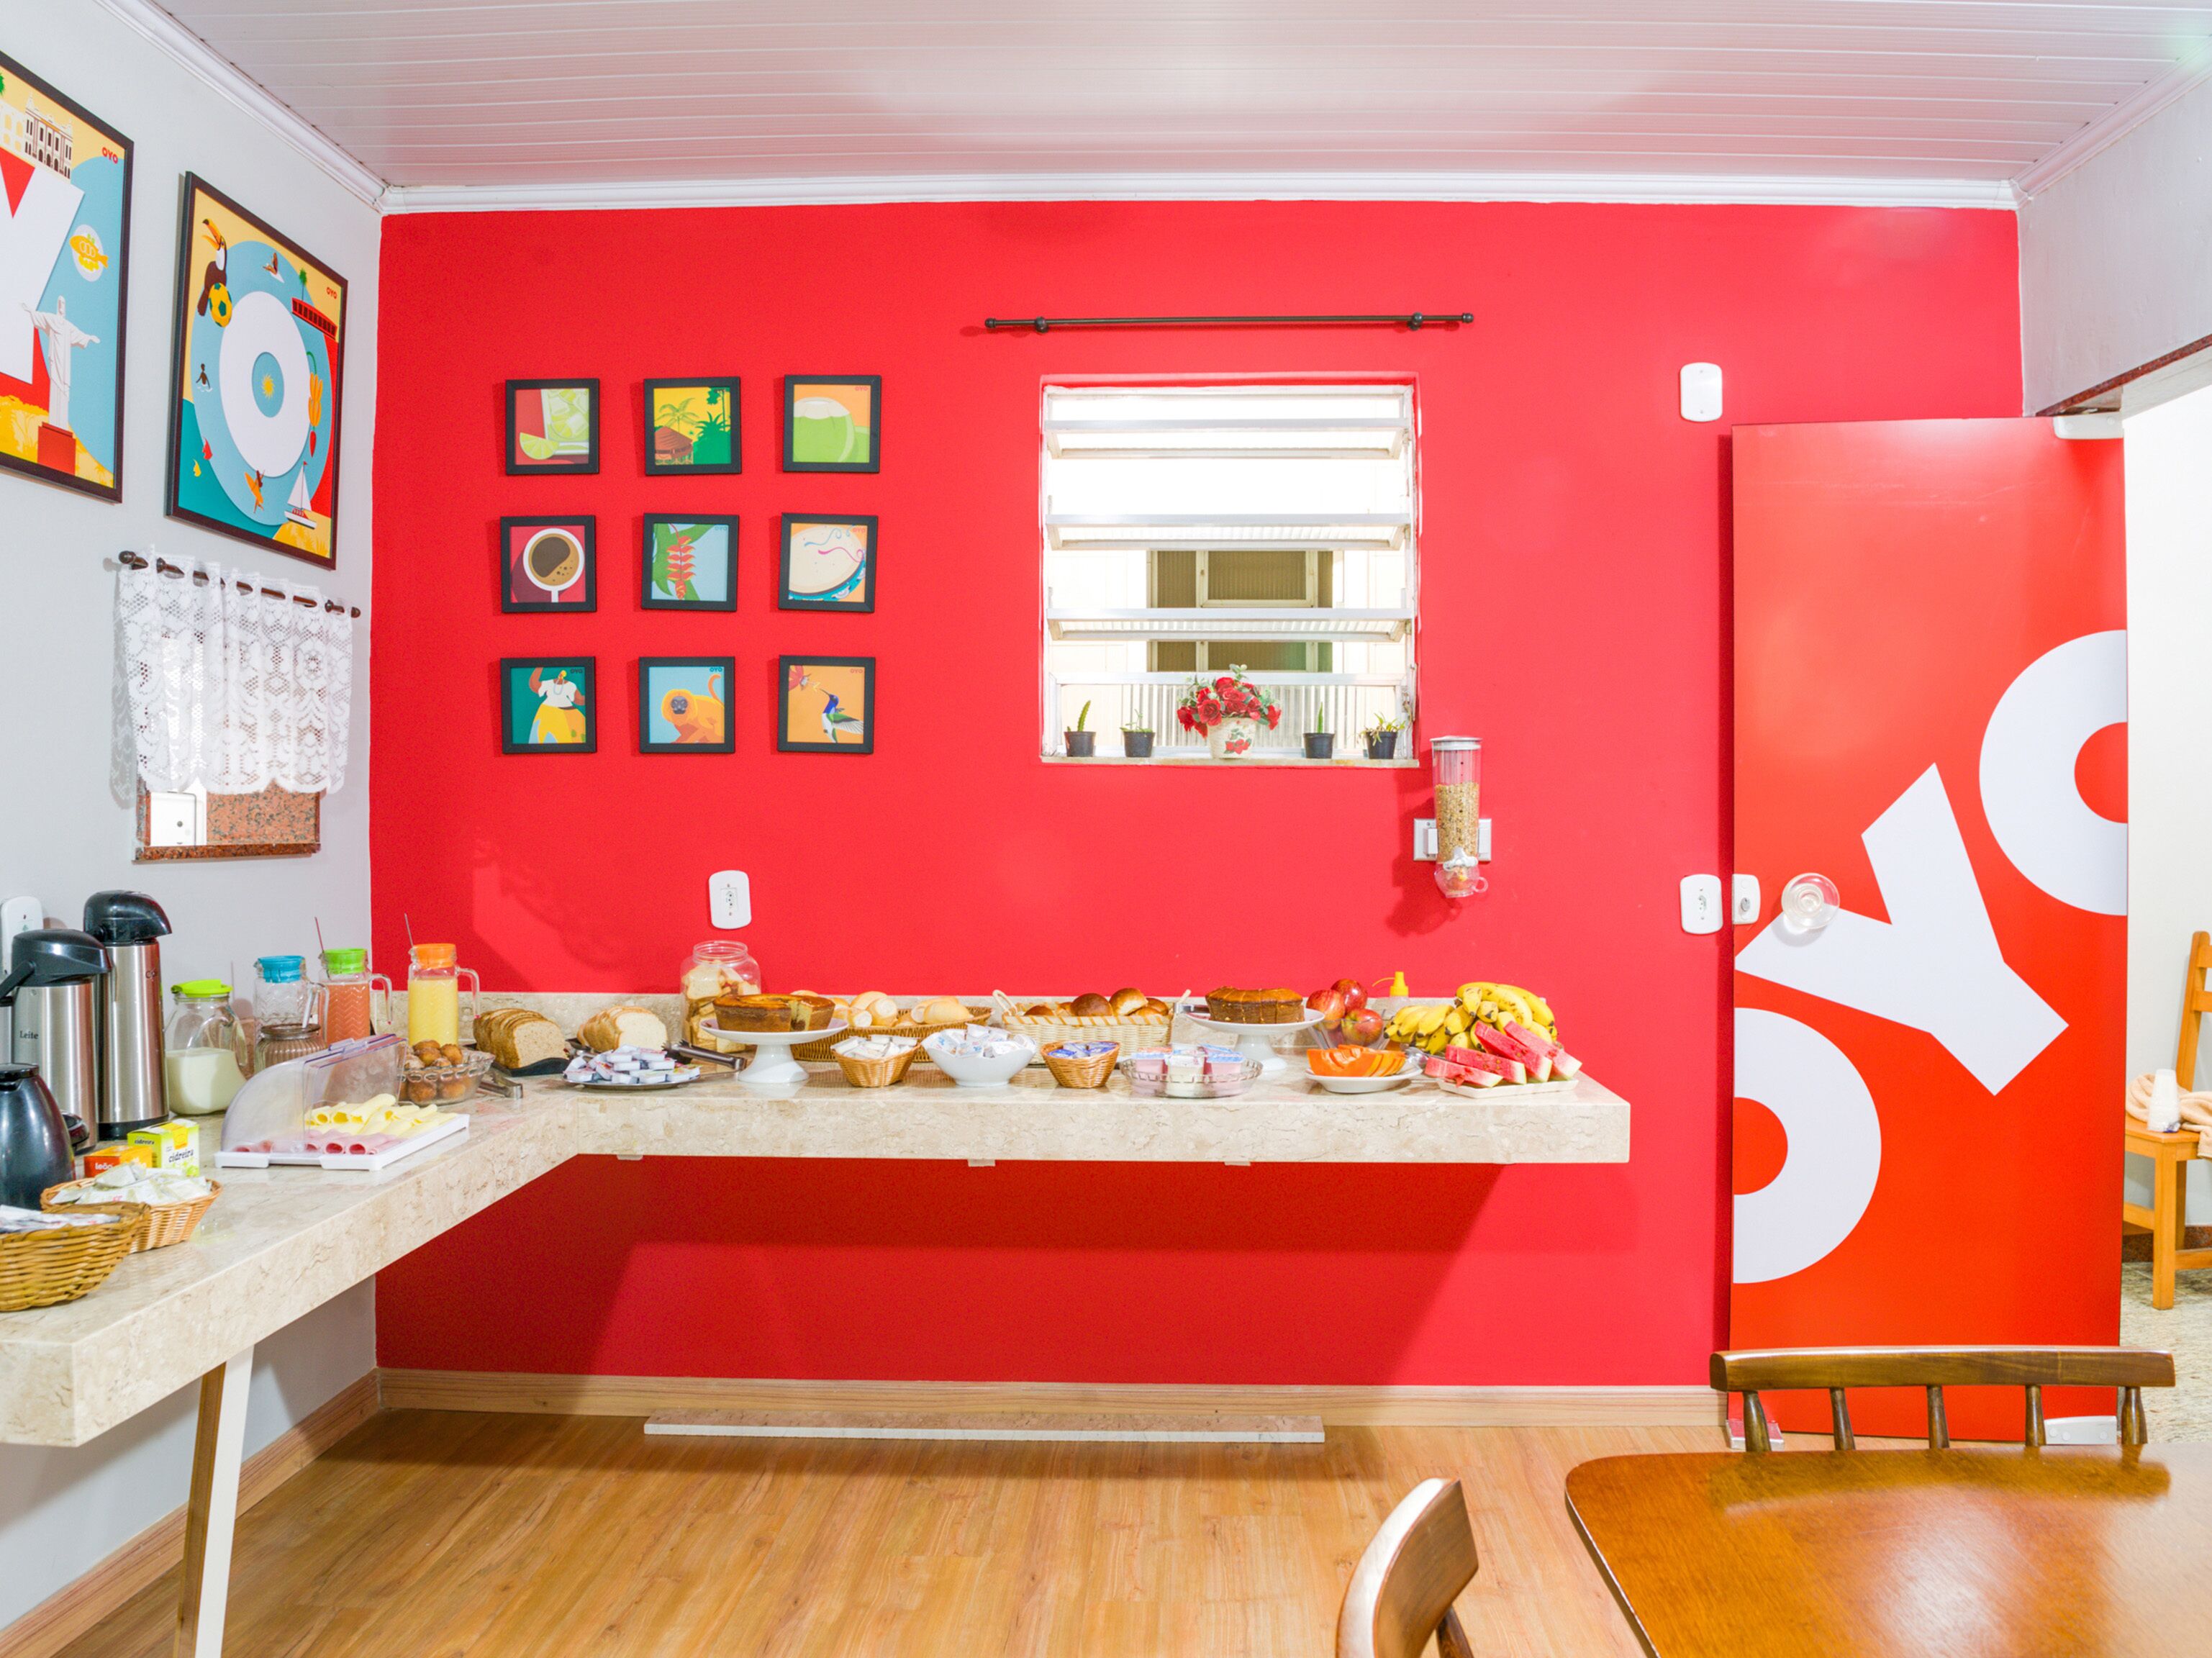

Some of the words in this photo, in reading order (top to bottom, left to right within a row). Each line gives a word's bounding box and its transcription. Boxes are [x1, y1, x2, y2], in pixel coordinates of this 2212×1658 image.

[102, 147, 118, 164] OYO
[326, 287, 337, 299] OYO
[19, 1030, 39, 1039] Leite
[169, 1149, 194, 1162] cidreira
